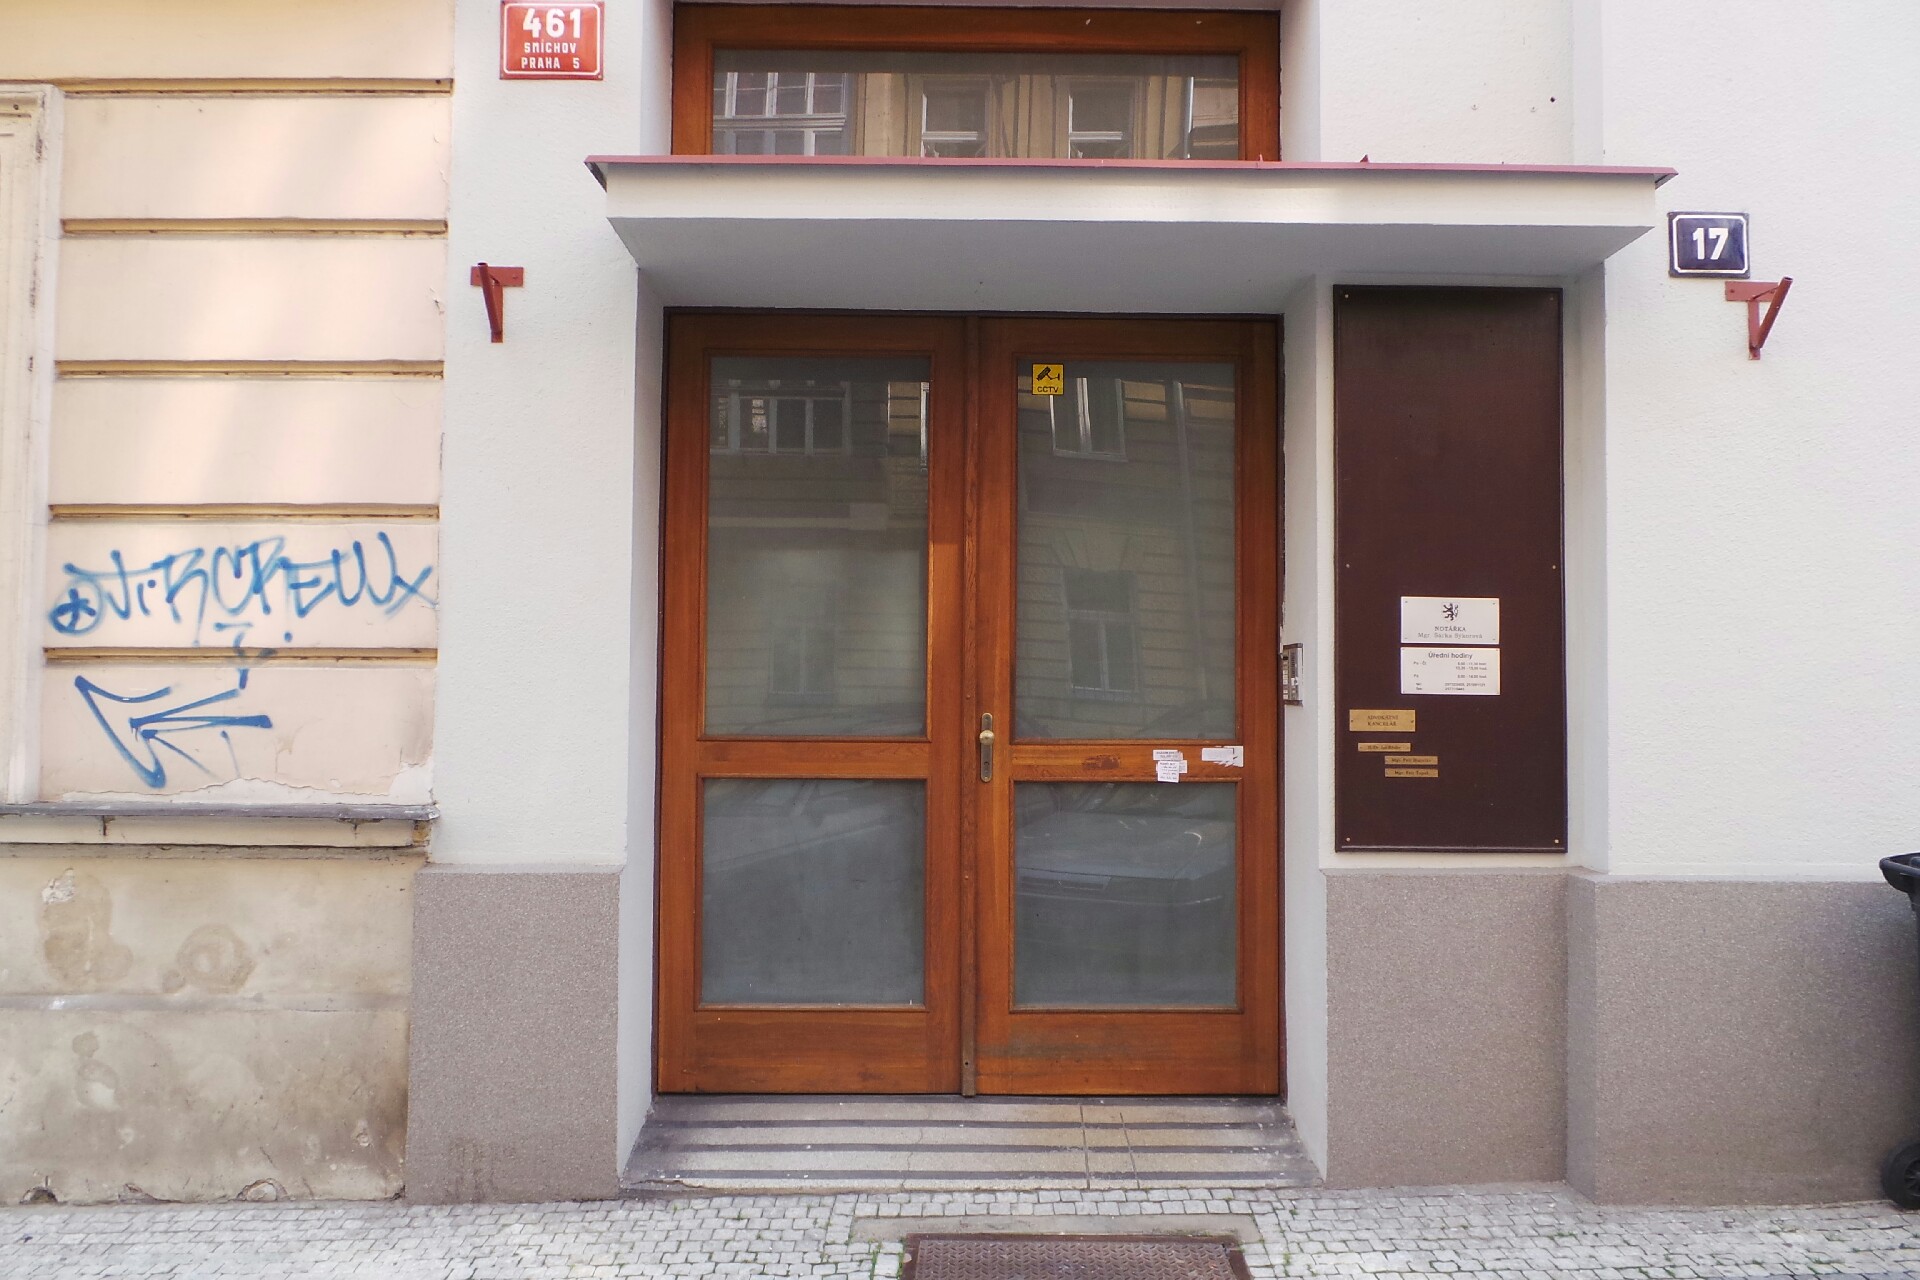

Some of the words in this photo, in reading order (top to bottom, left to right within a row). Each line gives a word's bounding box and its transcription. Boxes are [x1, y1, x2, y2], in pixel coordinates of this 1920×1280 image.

[522, 7, 581, 39] 461
[524, 40, 577, 54] SMÍCHOV
[521, 57, 561, 69] PRAHA
[572, 57, 580, 69] 5
[1692, 227, 1729, 260] 17
[1451, 652, 1473, 660] hodiny
